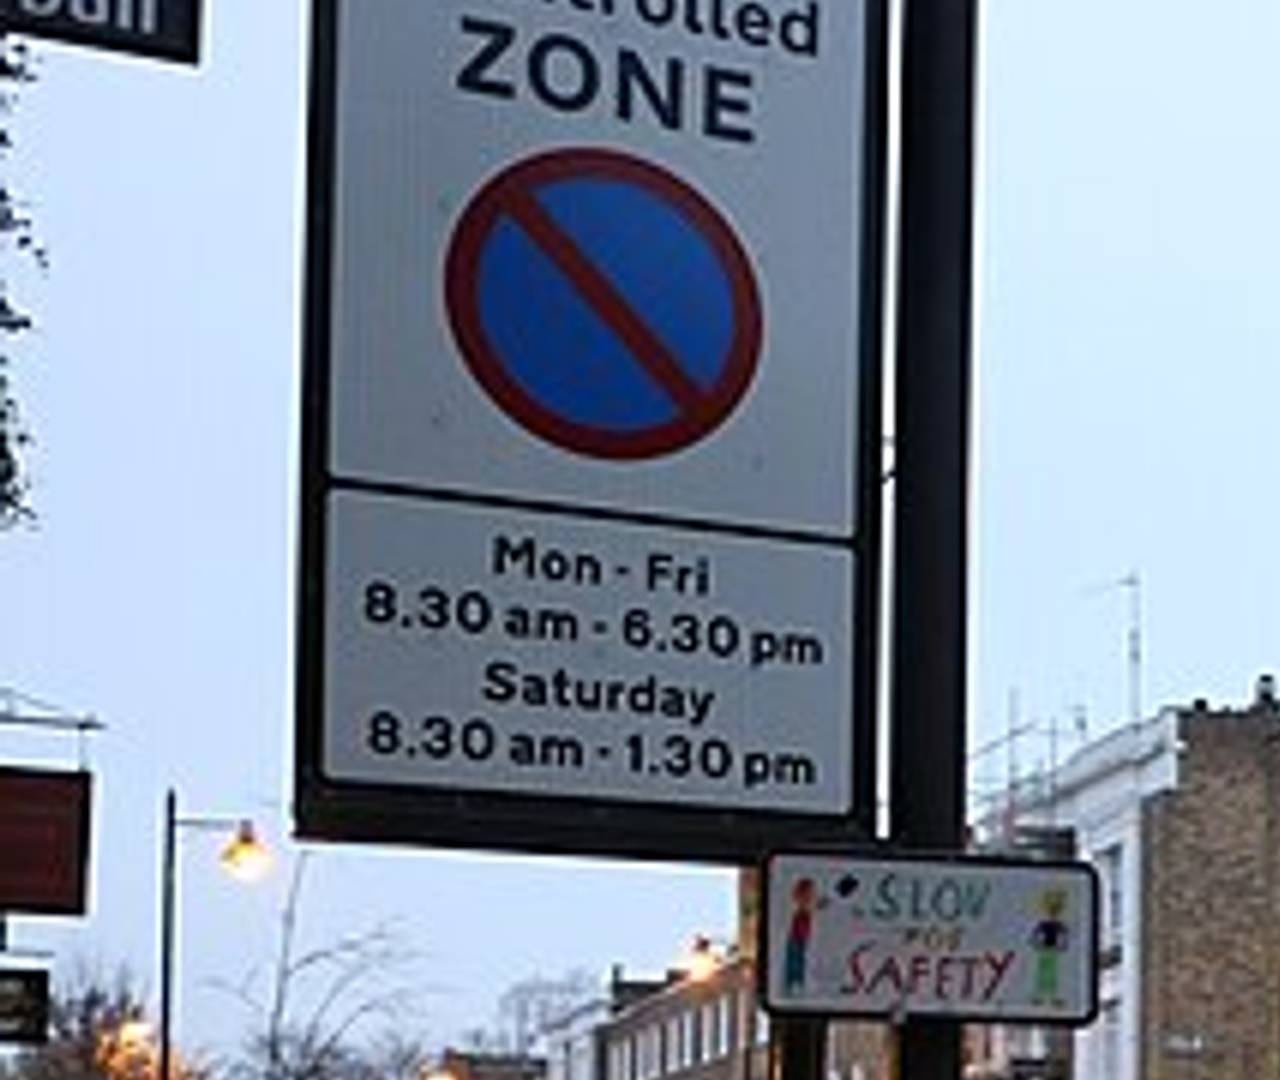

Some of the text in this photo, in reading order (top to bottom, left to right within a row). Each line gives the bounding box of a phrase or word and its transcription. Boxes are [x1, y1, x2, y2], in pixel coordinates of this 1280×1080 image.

[543, 0, 818, 57] olled
[455, 14, 756, 144] ZONE
[492, 535, 601, 585] Mon
[647, 555, 709, 596] Fri
[363, 583, 491, 633] 8.30
[504, 604, 578, 642] am
[622, 608, 739, 659] 6.30
[750, 628, 824, 667] pm
[482, 662, 715, 726] Saturday
[367, 711, 495, 762] 8.30
[508, 732, 583, 769] am
[627, 734, 732, 779] 1.30
[743, 746, 816, 789] pm
[839, 939, 1017, 1001] SAFETY
